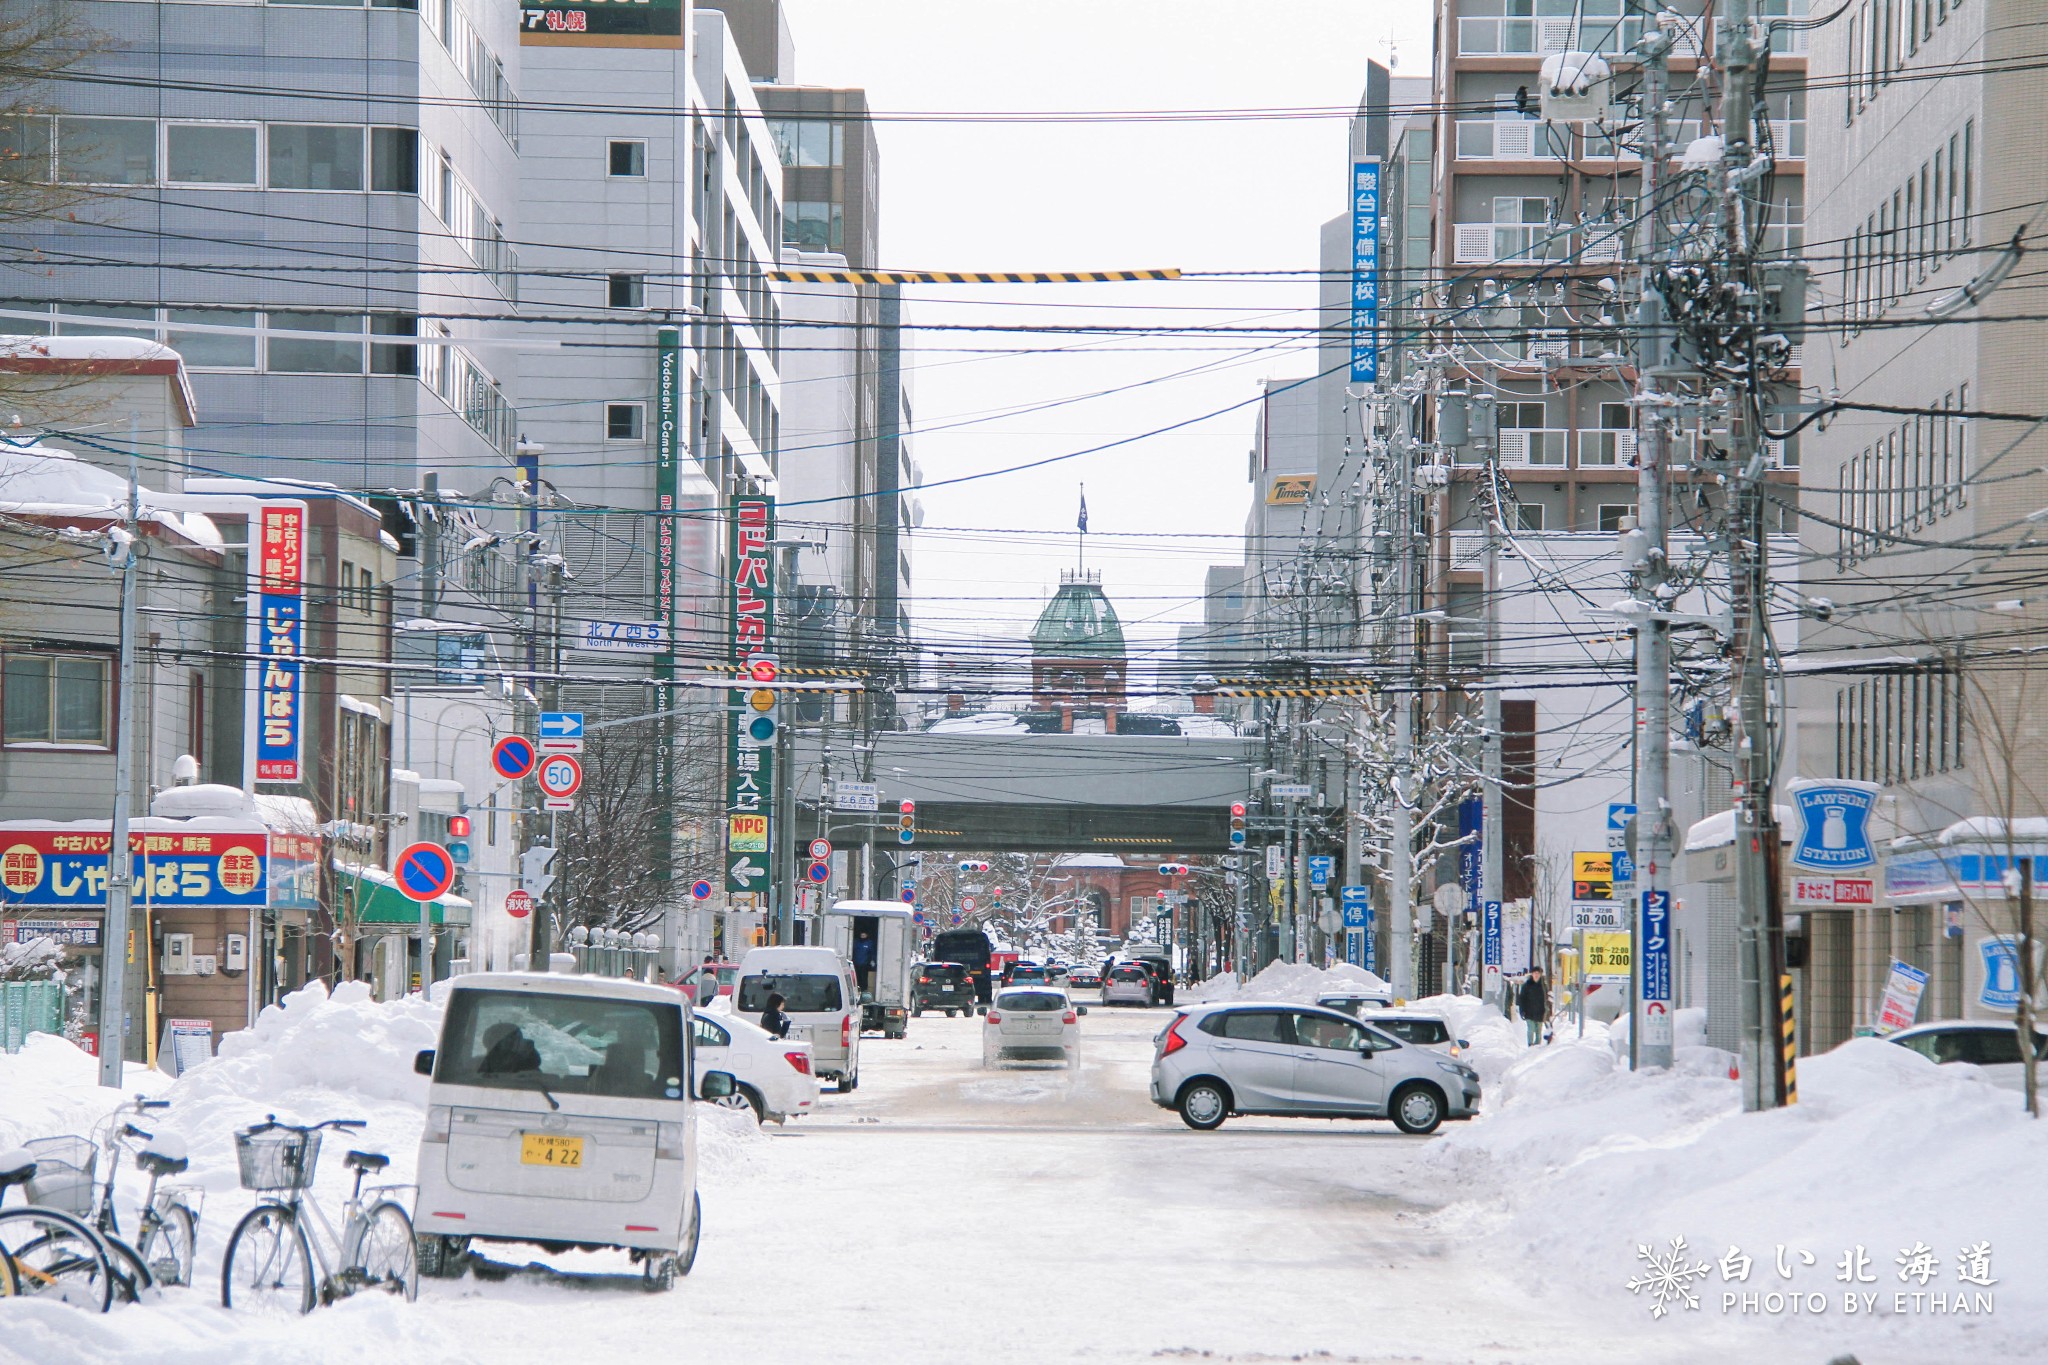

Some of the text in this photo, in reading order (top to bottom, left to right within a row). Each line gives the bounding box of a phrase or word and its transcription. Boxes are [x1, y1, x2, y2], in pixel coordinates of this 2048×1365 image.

[1355, 172, 1377, 300] 駿台予備学校
[661, 353, 674, 467] Yodobashi-Camera
[264, 606, 294, 746] じゃんぱら
[260, 764, 294, 775] 札幌店
[549, 766, 572, 786] 50
[1802, 794, 1868, 808] LAWSON
[733, 818, 764, 834] NPC
[814, 844, 827, 855] 50
[1802, 847, 1867, 861] STATION
[6, 853, 37, 868] 高価
[223, 855, 254, 871] 査定
[1584, 862, 1612, 873] Times
[1616, 856, 1634, 877] 停
[6, 871, 37, 886] 買取
[223, 871, 254, 887] 無料
[1575, 882, 1590, 899] P
[506, 898, 532, 911] 消火栓
[1346, 906, 1364, 923] 停
[1488, 903, 1499, 936] クラーク
[1576, 914, 1614, 925] 30 200
[1589, 954, 1629, 966] 30 200
